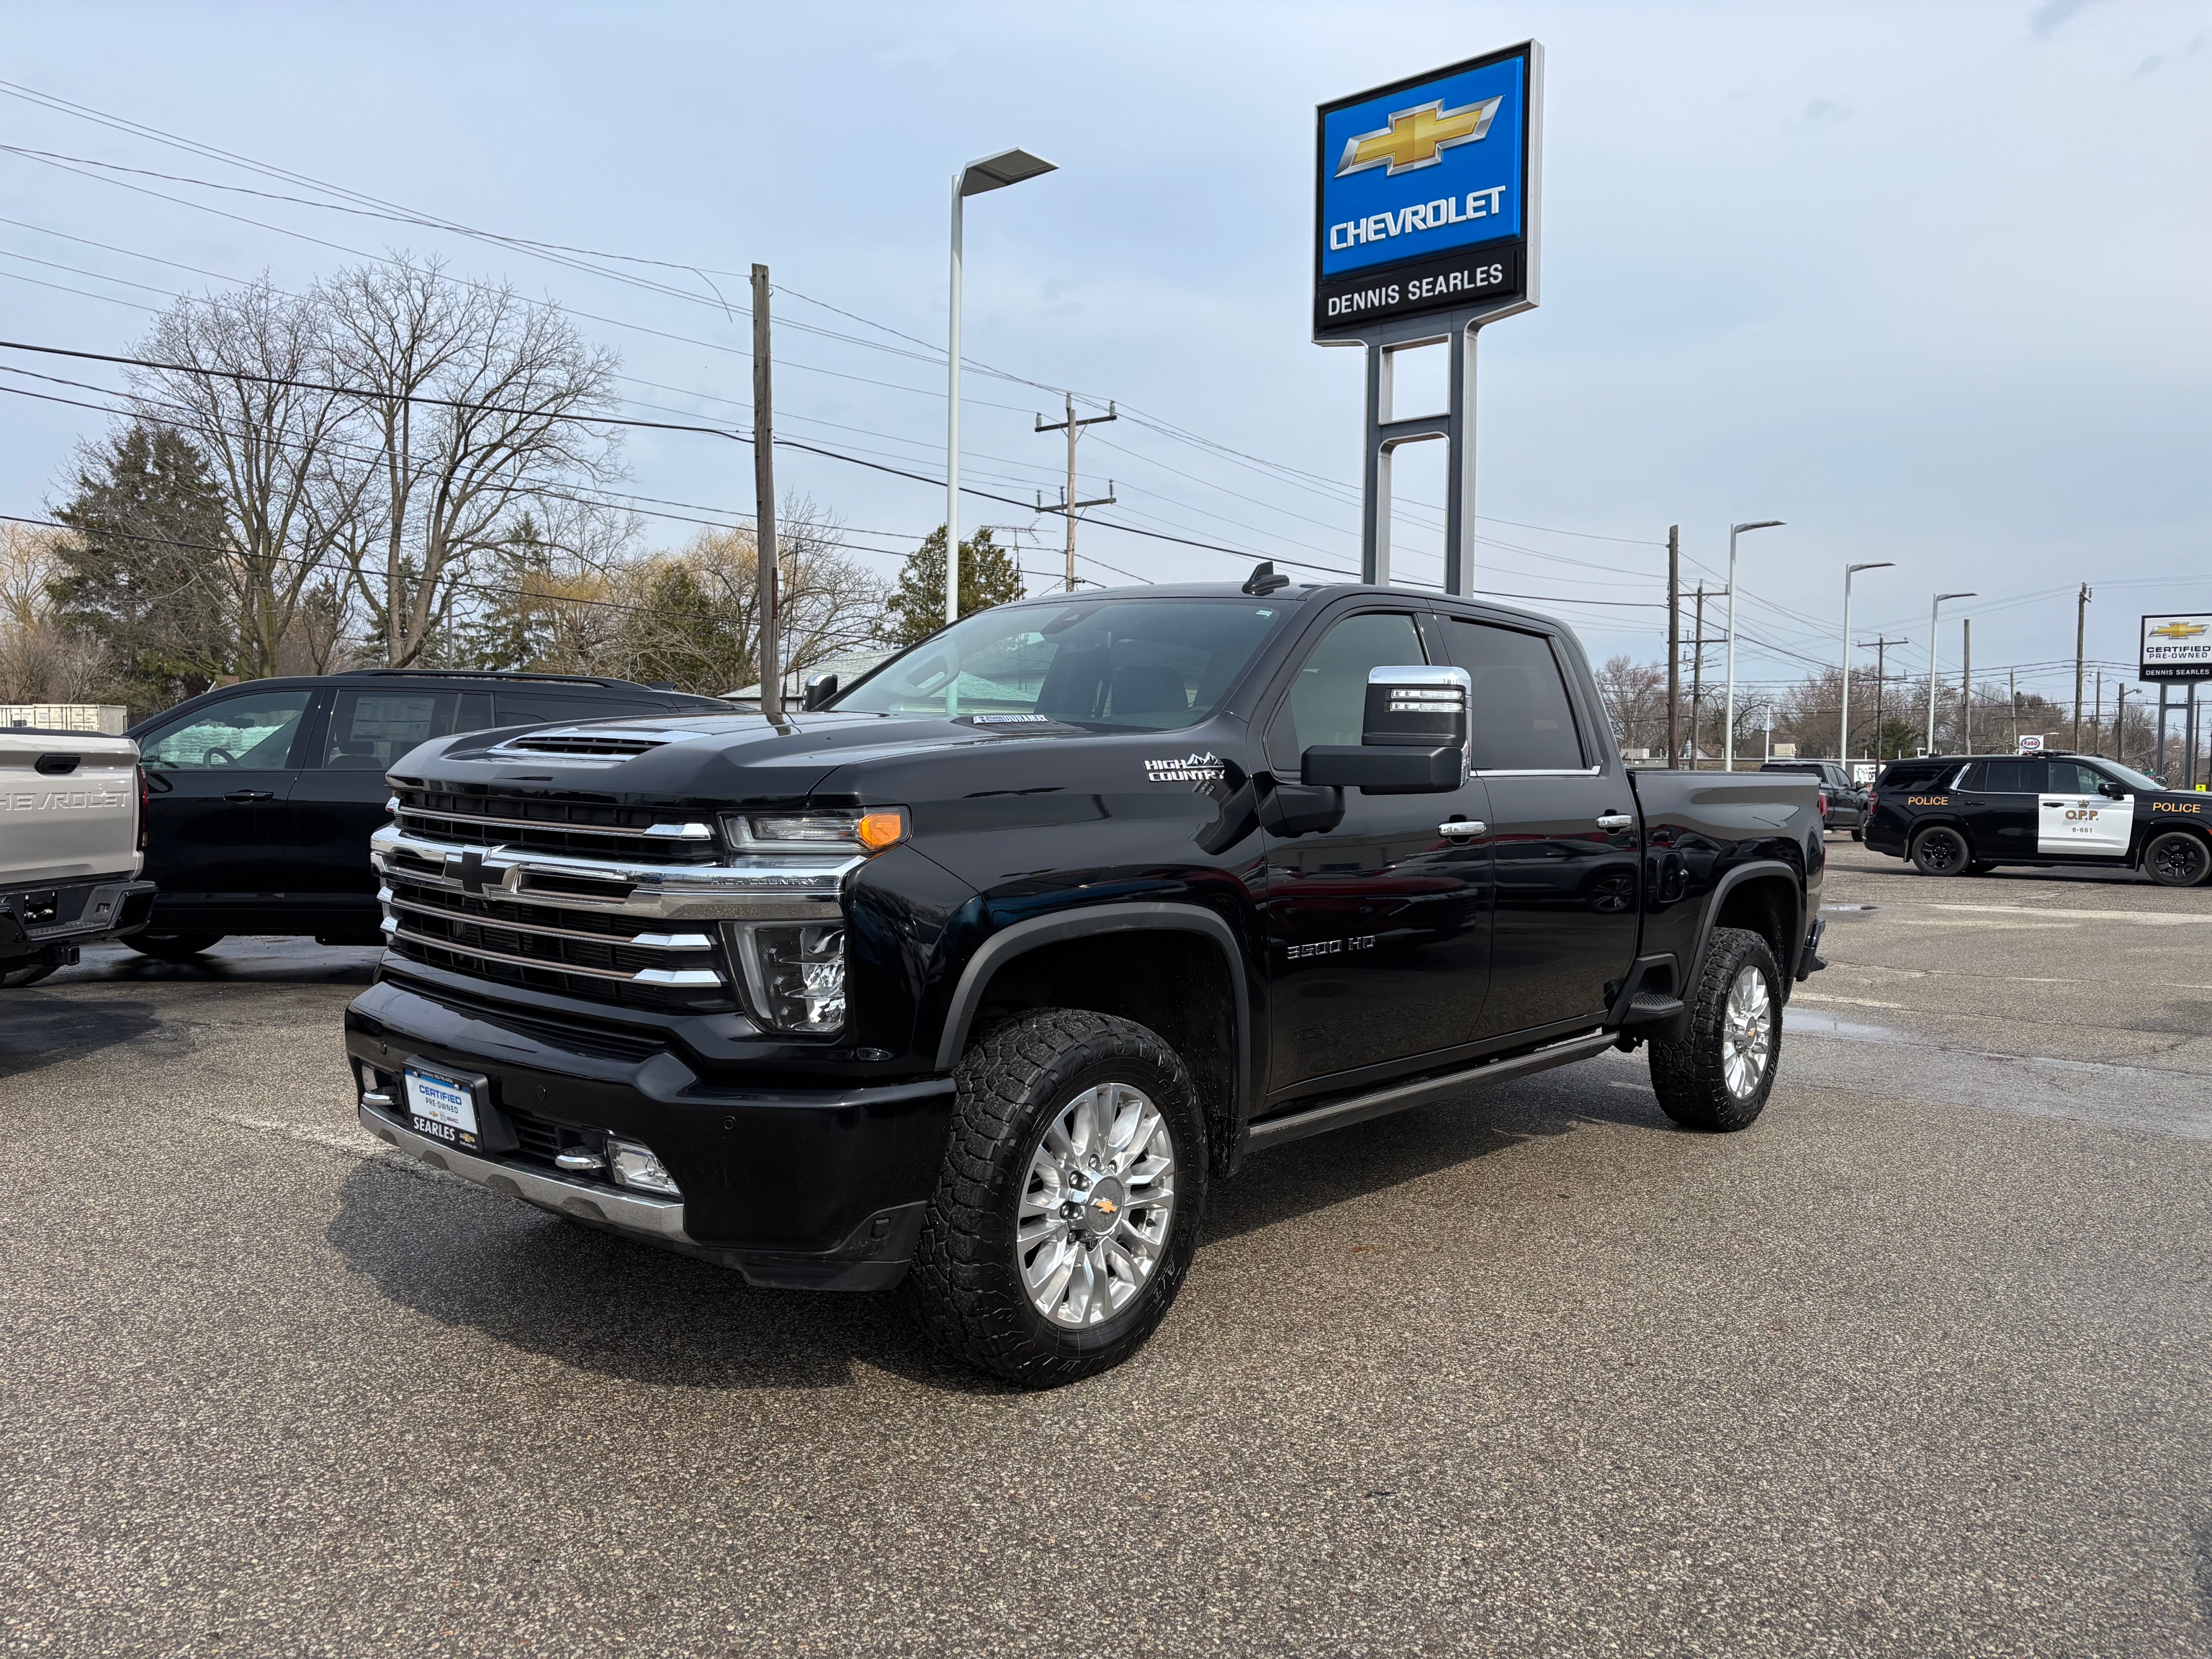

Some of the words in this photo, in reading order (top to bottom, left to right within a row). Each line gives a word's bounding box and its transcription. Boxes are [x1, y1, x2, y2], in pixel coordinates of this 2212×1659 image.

[1330, 186, 1506, 251] CHEVROLET
[1328, 284, 1400, 316] DENNIS
[1408, 264, 1503, 300] SEARLES
[1144, 760, 1187, 770] HIGH
[1148, 770, 1225, 782] COUNTRY
[0, 791, 130, 811] HEVROLET
[1908, 796, 1948, 806] POLICE
[2152, 802, 2201, 813] POLICE
[2065, 810, 2099, 821] O.P.P.
[1287, 940, 1342, 960] 3500
[1348, 935, 1375, 950] HD
[419, 1084, 462, 1105] CERTIFIED
[426, 1097, 459, 1114] PRE-OWNED
[413, 1116, 456, 1141] SEARLES
